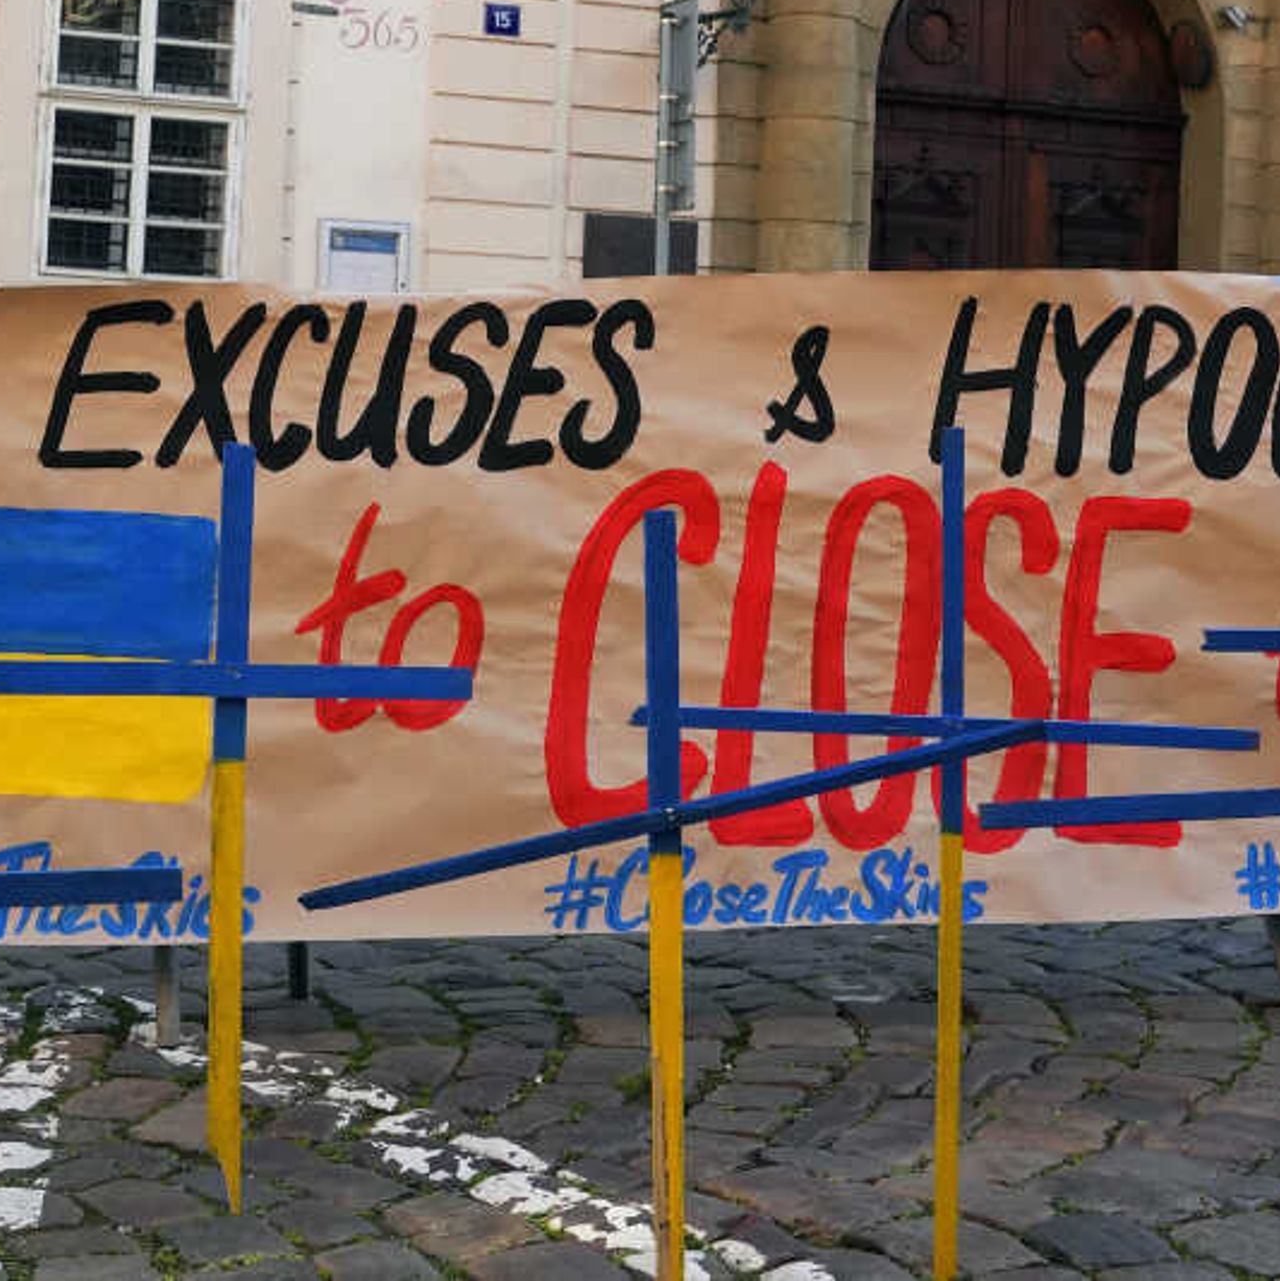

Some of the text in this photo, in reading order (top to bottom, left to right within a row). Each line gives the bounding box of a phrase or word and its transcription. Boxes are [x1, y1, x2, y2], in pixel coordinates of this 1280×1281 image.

[493, 10, 513, 29] 15
[39, 300, 655, 472] EXCUSES
[764, 325, 835, 442] &
[295, 501, 485, 732] to
[544, 461, 1193, 853] CLOSE
[544, 844, 989, 932] #CoseTheSkis
